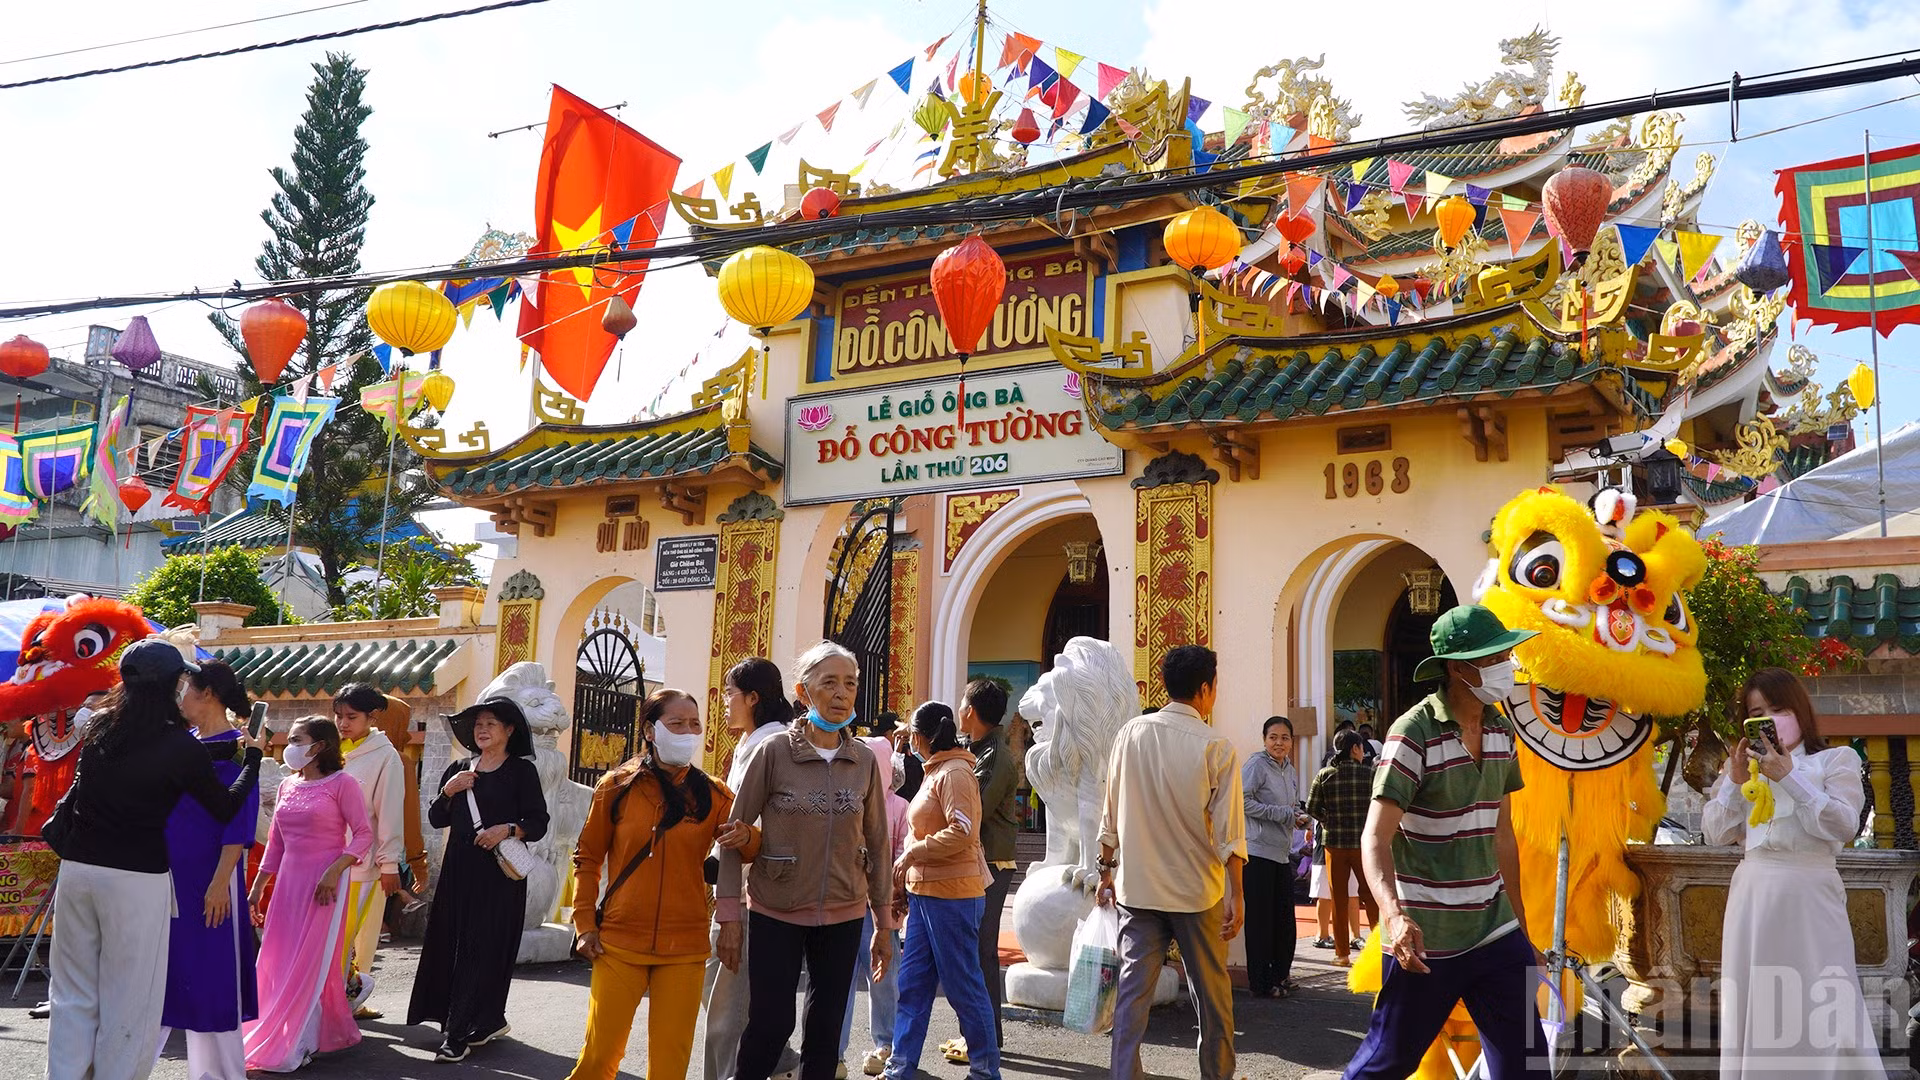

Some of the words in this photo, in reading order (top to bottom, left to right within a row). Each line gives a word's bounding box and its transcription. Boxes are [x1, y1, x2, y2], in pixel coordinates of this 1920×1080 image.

[902, 283, 933, 299] TH
[868, 395, 892, 421] LỄ
[899, 390, 935, 417] GIỖ
[995, 382, 1025, 405] BÀ
[817, 424, 861, 463] ĐỖ
[869, 424, 956, 457] CÔNG
[966, 407, 1083, 446] TƯỜNG
[881, 459, 919, 483] LẦN
[971, 455, 1007, 473] 206
[1323, 457, 1410, 499] 1963
